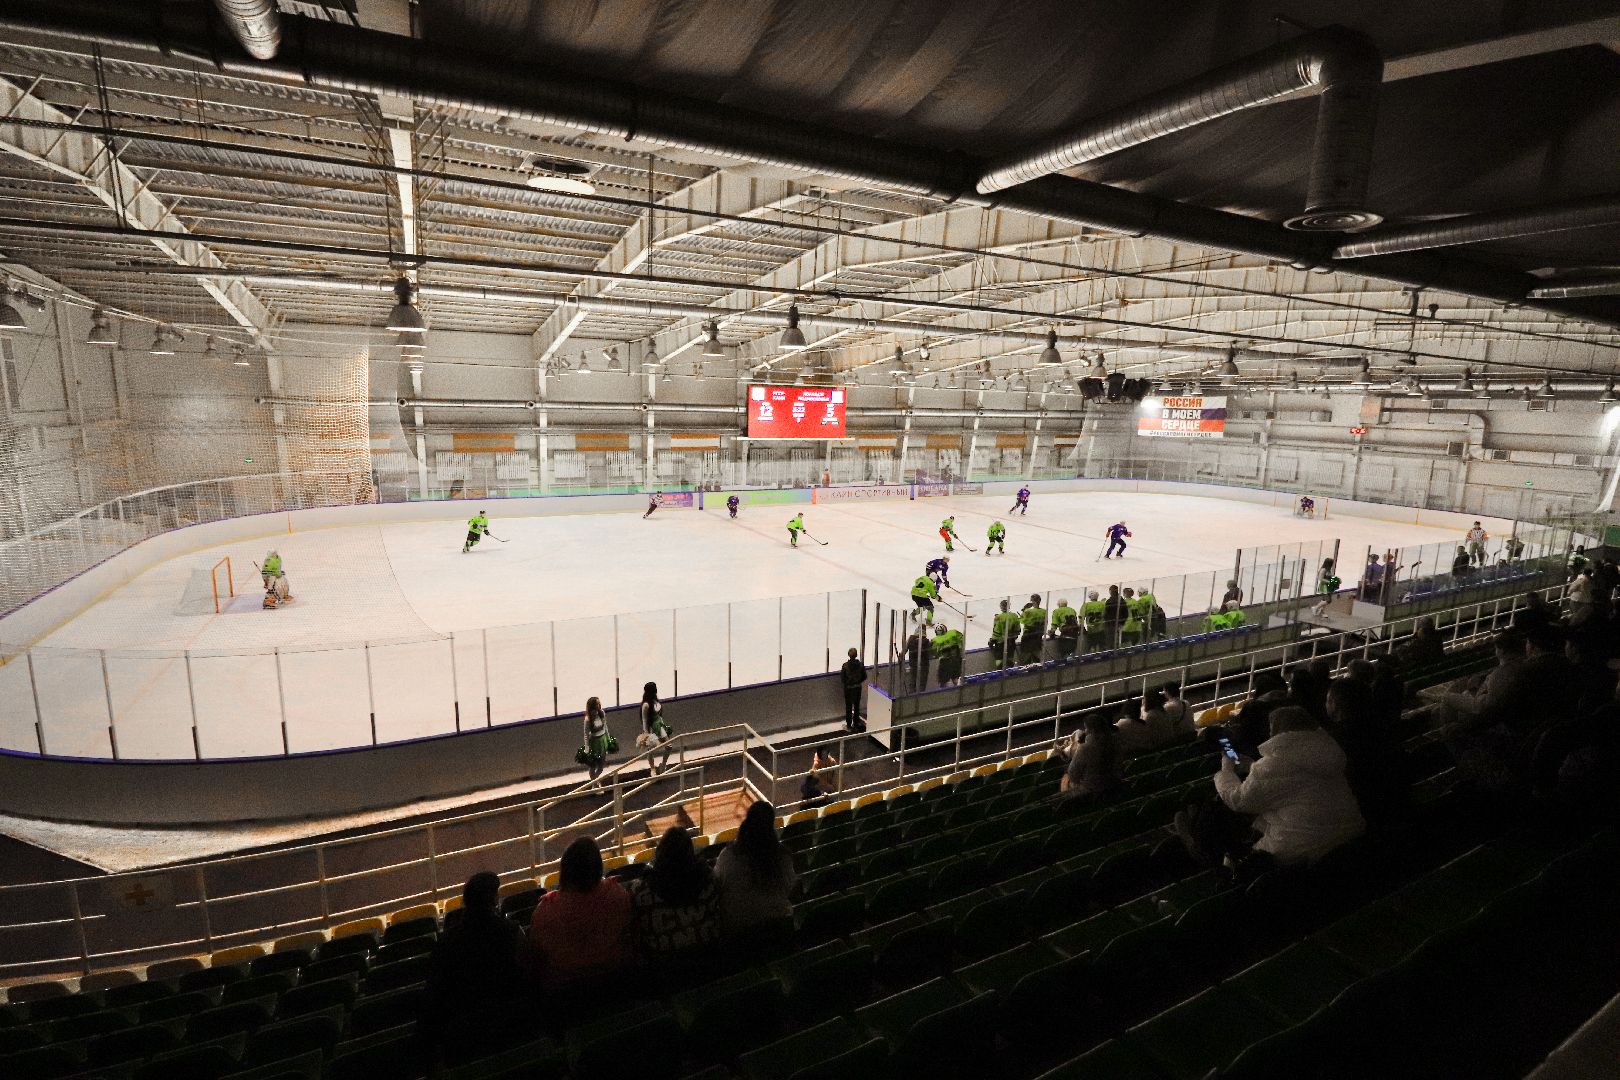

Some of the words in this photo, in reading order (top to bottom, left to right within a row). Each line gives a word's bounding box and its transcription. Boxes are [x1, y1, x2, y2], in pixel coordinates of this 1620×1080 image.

[1163, 397, 1203, 407] РОССИЯ
[1162, 409, 1170, 419] В
[1171, 409, 1202, 420] МОЕМ
[1162, 419, 1201, 431] СЕРДЦЕ
